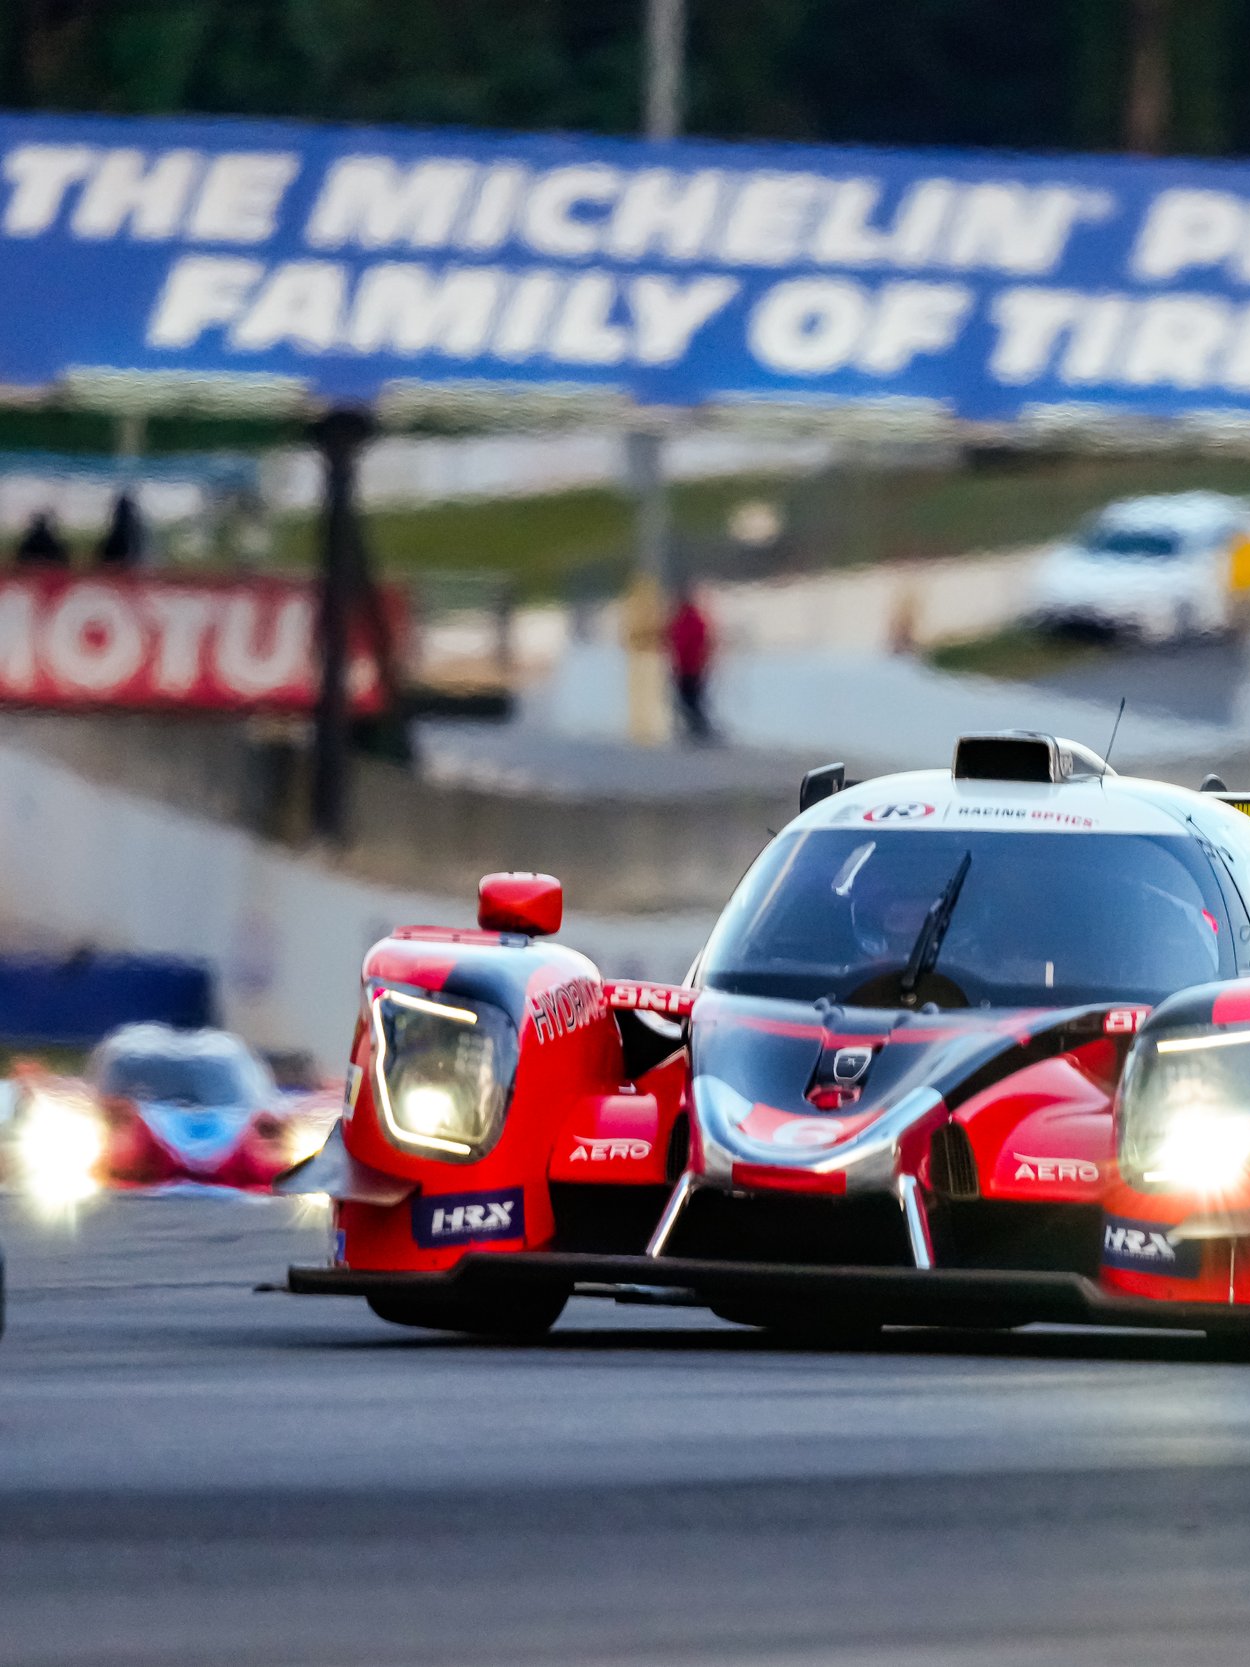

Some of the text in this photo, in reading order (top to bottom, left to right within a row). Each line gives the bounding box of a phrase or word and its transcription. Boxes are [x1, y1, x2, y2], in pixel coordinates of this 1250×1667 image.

[4, 144, 299, 242] THE
[304, 154, 1080, 275] MICHELIN
[145, 255, 742, 366] FAMILY
[746, 275, 975, 375] OF
[569, 1143, 652, 1162] AERO
[1014, 1162, 1099, 1182] AERO
[431, 1201, 514, 1234] HRX
[1104, 1225, 1176, 1258] HRX
